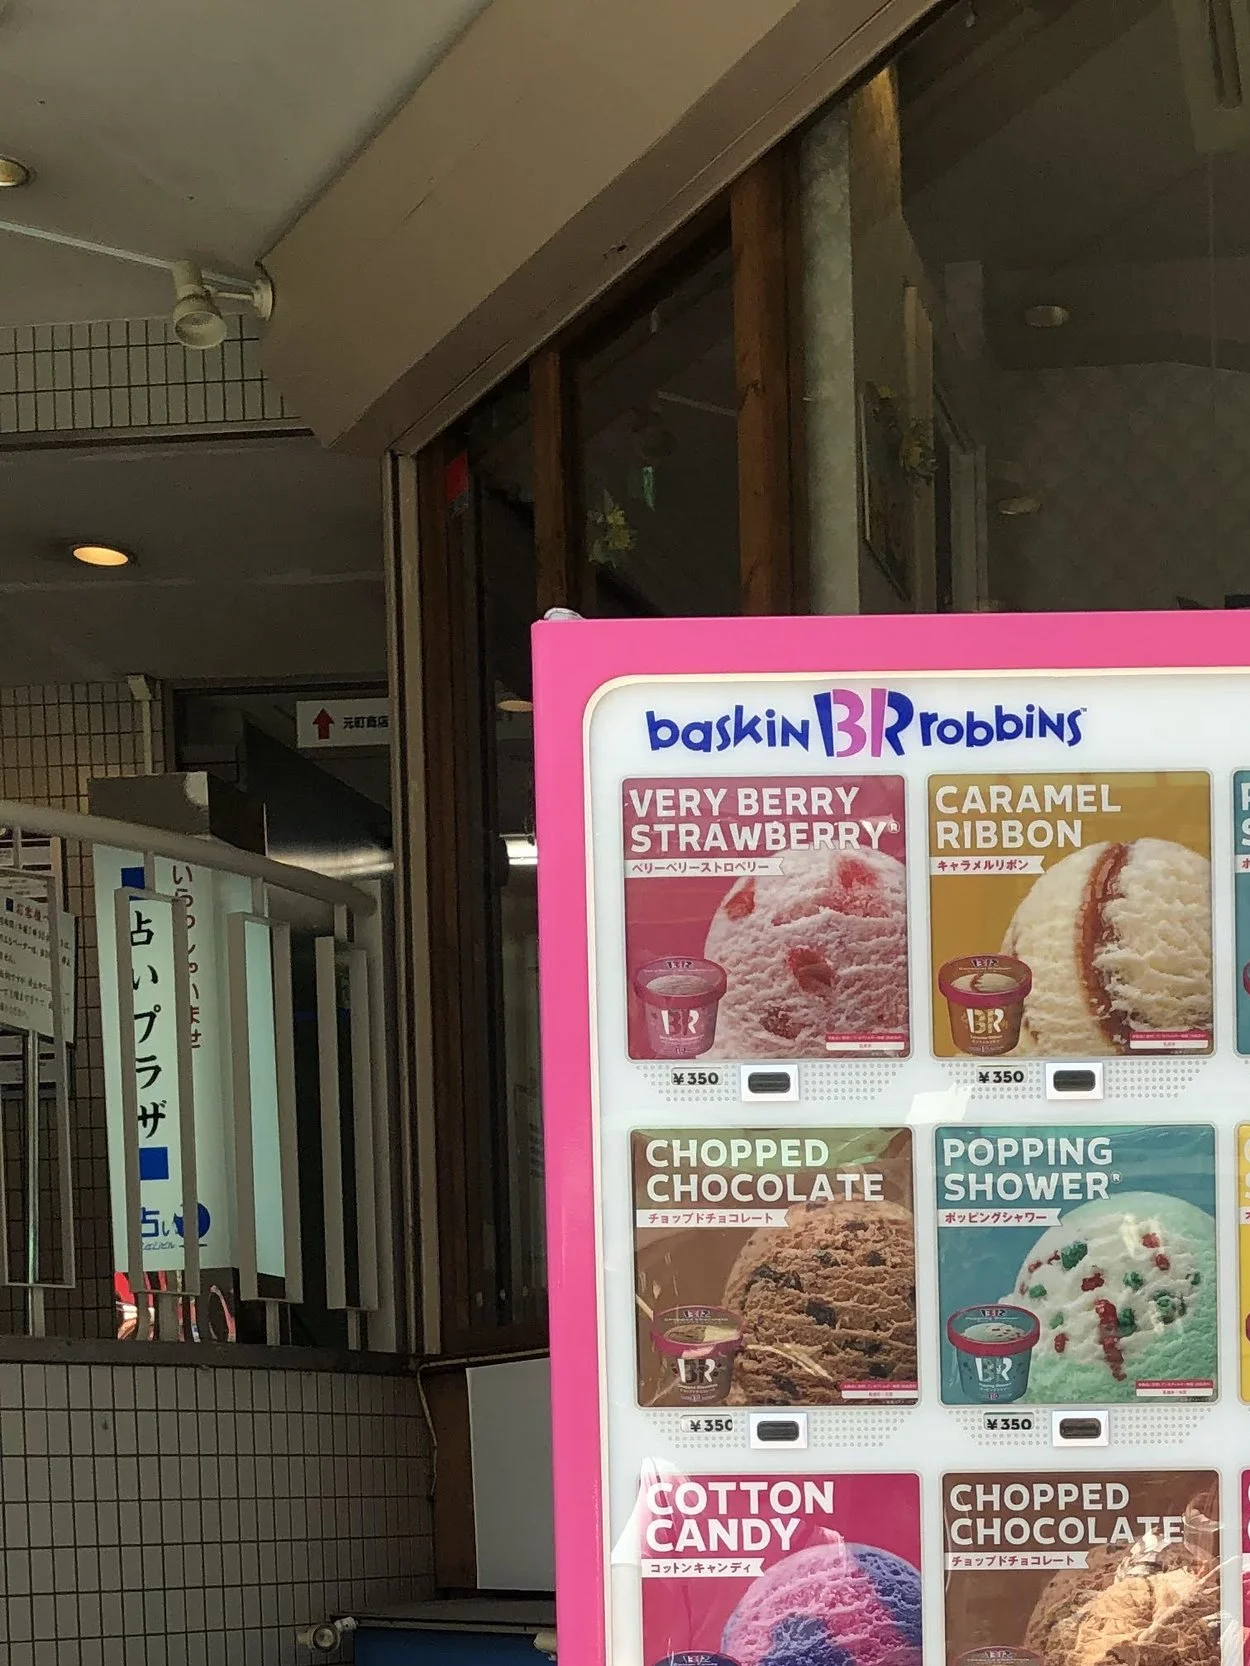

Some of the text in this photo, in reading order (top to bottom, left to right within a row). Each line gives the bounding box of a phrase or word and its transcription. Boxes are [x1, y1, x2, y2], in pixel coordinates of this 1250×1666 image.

[647, 706, 810, 752] baskin
[814, 688, 914, 758] BR
[630, 785, 860, 818] VERY BERRY
[936, 784, 1122, 814] CARAMEL
[937, 819, 1082, 850] RIBBON
[632, 860, 769, 874] ベリーベリーストロベリー
[937, 858, 1029, 872] キャラメルリボン
[131, 911, 167, 1138] 占いプラザ
[673, 1072, 719, 1086] ¥350
[979, 1070, 1024, 1084] ¥350
[646, 1138, 829, 1168] CHOPPED
[944, 1137, 1112, 1166] POPPING
[647, 1173, 884, 1202] CHOCOLATE
[648, 1211, 774, 1224] チョップドチョコレート
[945, 1211, 1047, 1224] ポッピングシャワー
[986, 1417, 1032, 1431] ¥350
[647, 1481, 834, 1516] COTTON
[950, 1482, 1129, 1511] CHOPPED
[646, 1518, 800, 1552] CANDY
[950, 1516, 1184, 1545] CHOCOLATE
[650, 1562, 751, 1574] コットンキャンディ
[952, 1554, 1074, 1567] チョップドチョコレート
